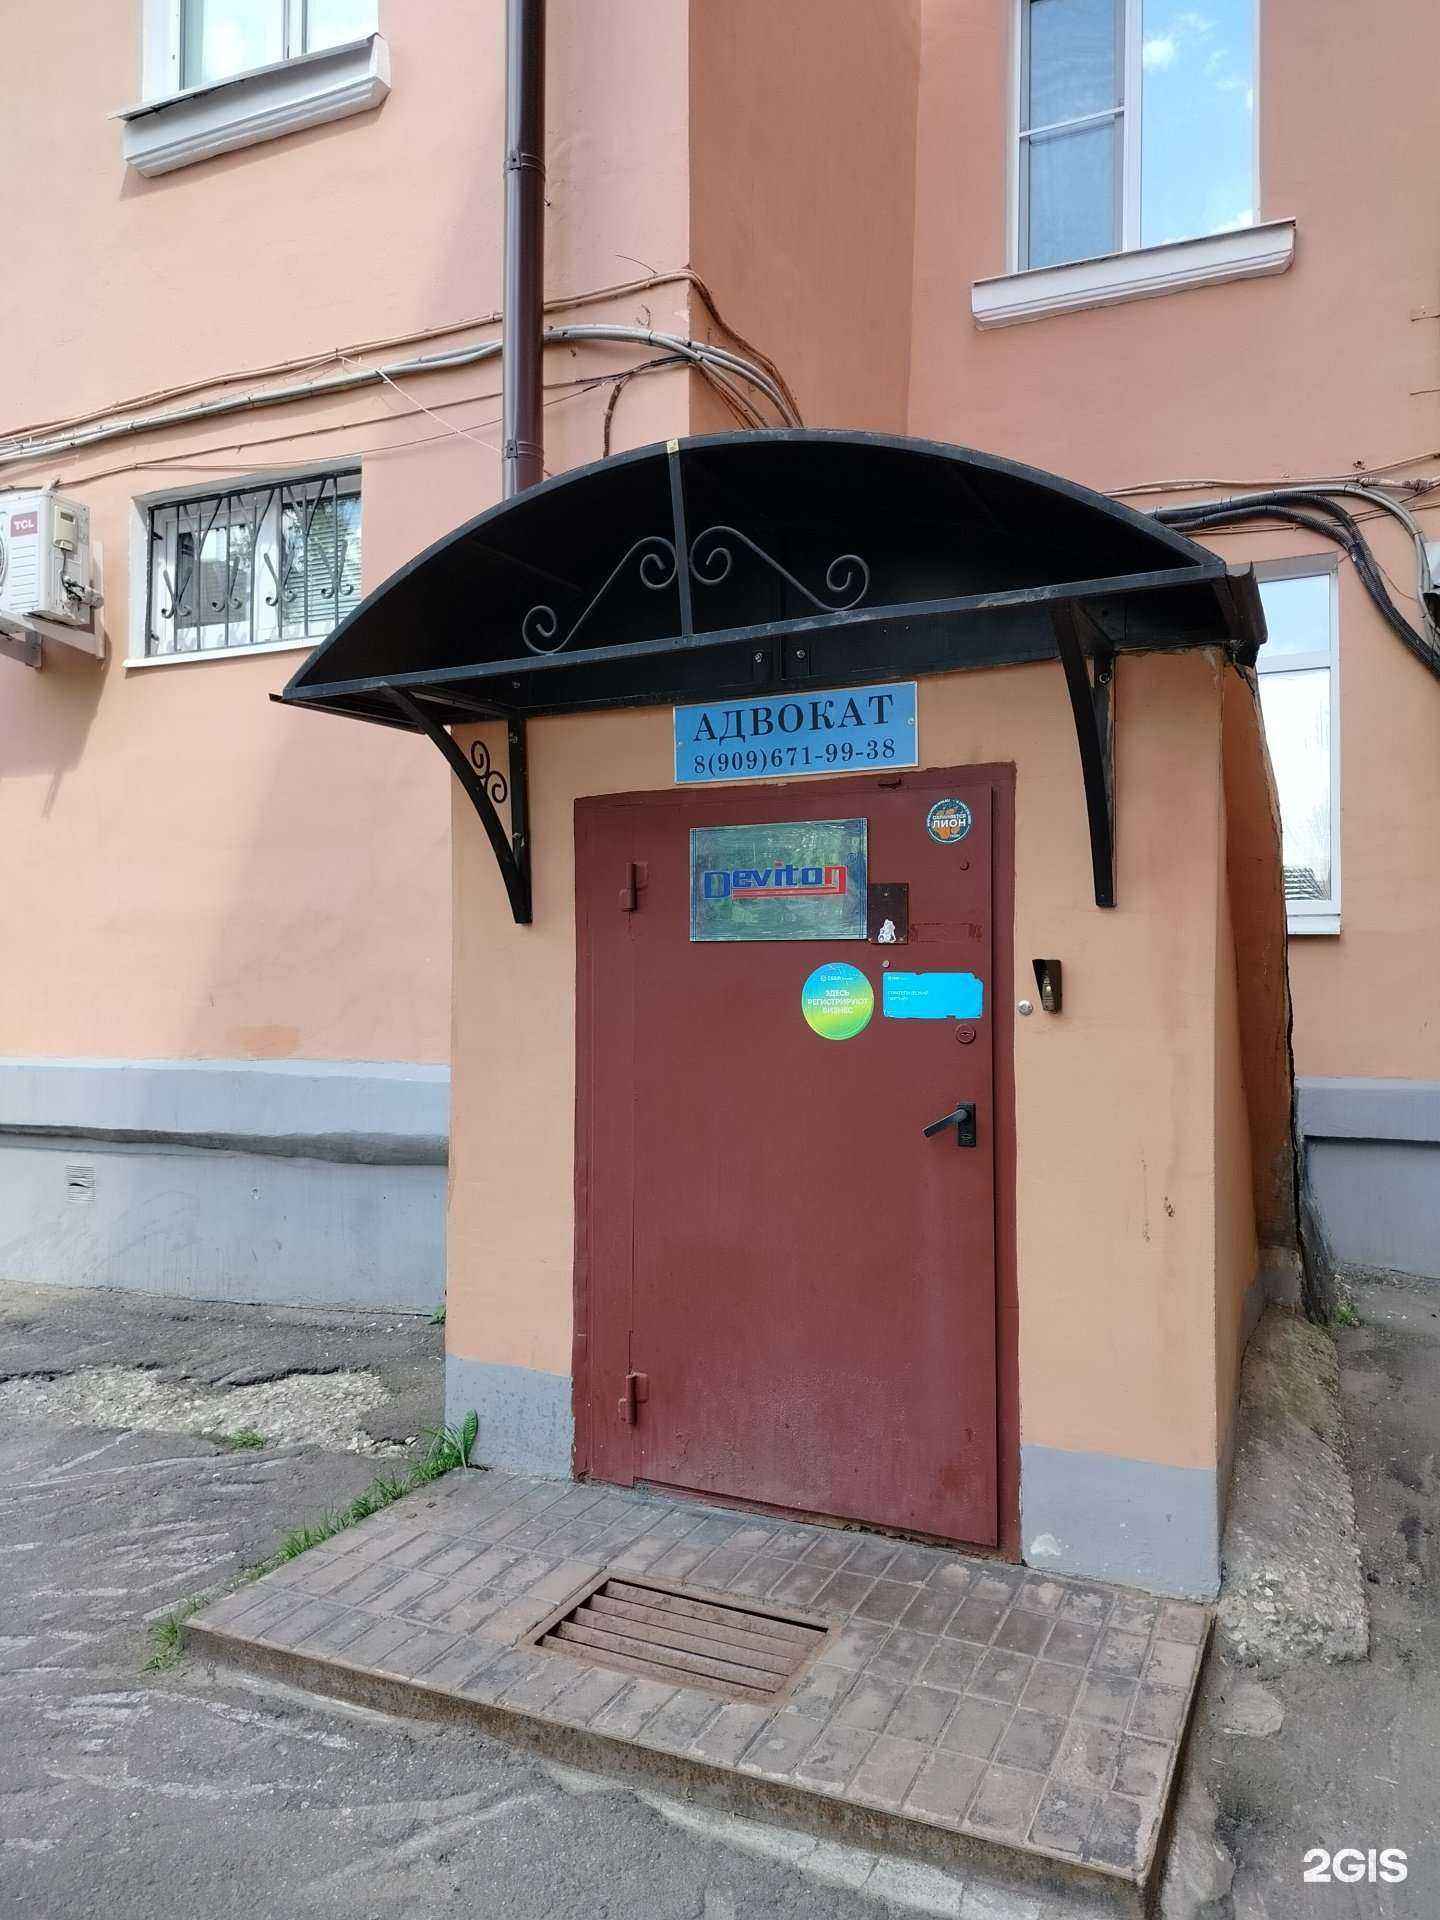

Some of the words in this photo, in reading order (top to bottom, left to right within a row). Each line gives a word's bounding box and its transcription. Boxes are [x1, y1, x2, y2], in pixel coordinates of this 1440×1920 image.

[14, 519, 35, 530] TCL
[693, 694, 894, 746] АДВОКАТ
[693, 738, 895, 775] 8(909)671-99-38
[932, 818, 967, 829] ЛИОН
[703, 859, 849, 900] Deviton
[825, 989, 850, 997] ЗДЕСЬ
